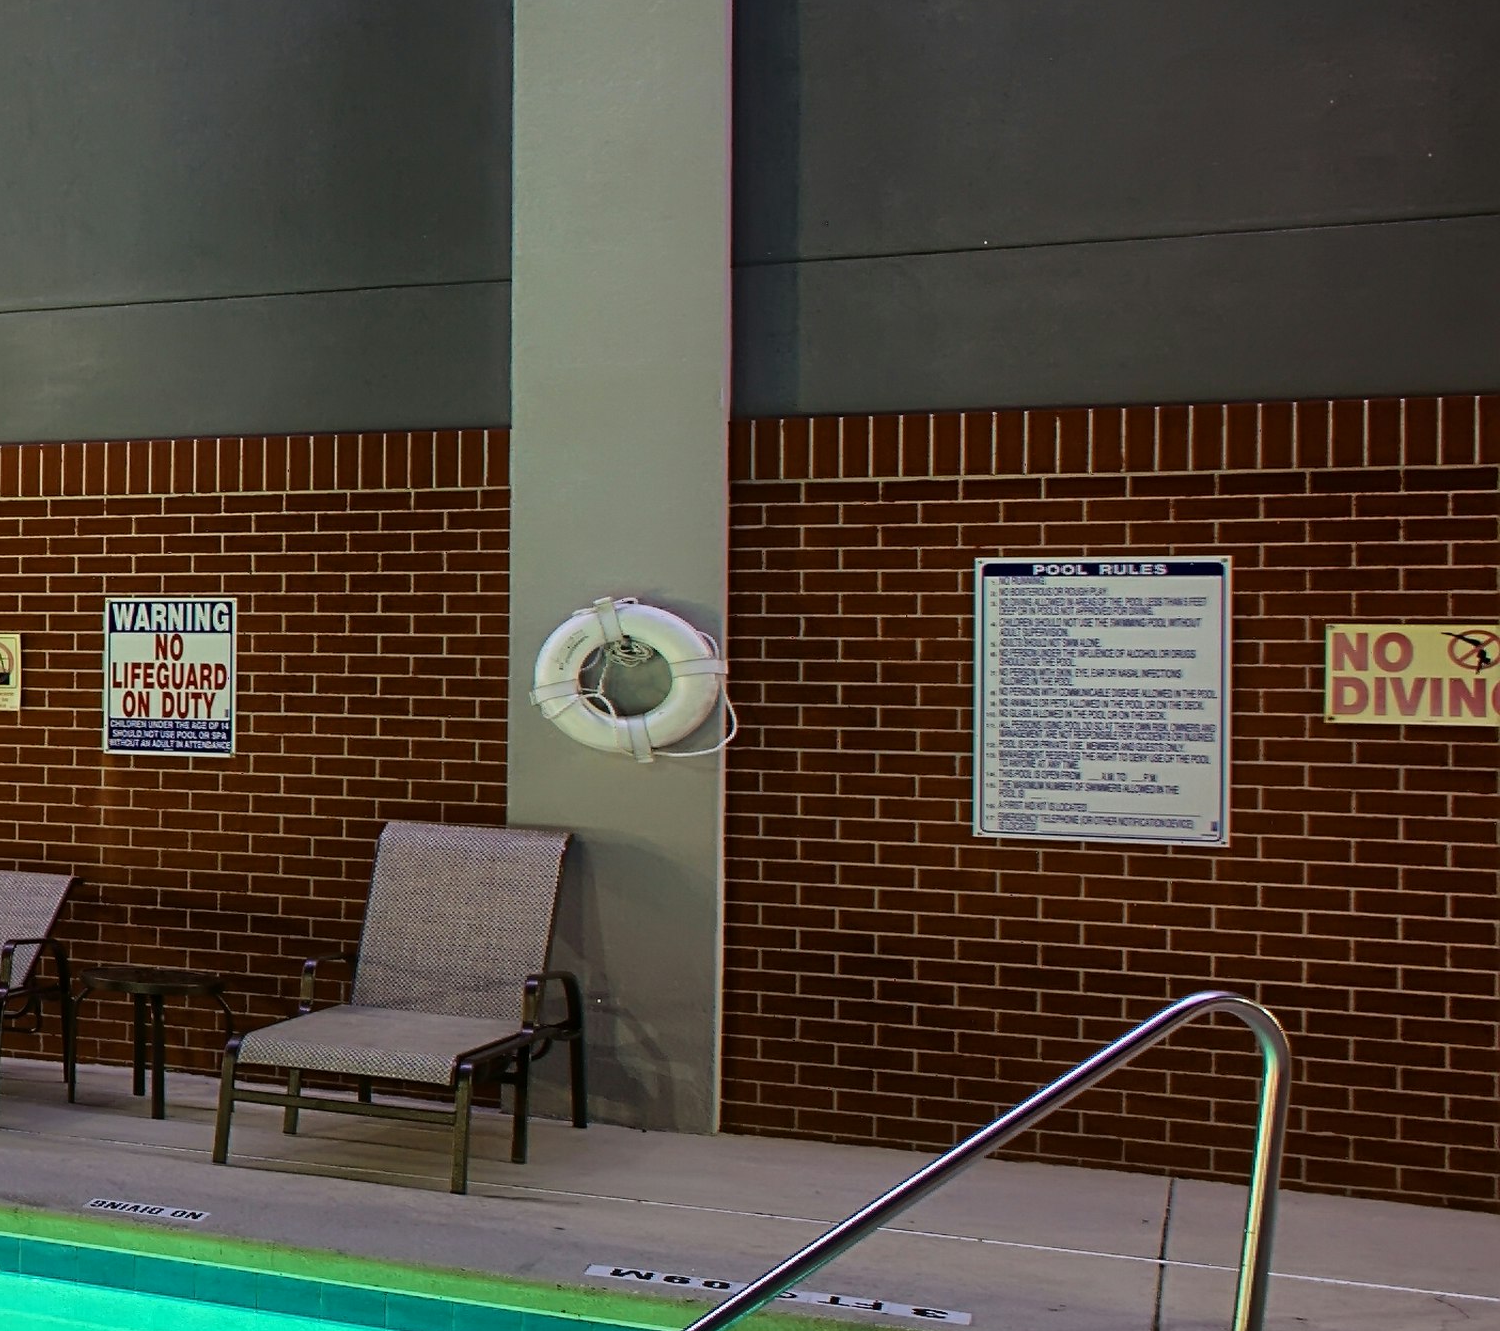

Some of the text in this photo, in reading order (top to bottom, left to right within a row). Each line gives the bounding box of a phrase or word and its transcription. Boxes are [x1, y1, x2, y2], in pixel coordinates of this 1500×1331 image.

[1032, 563, 1168, 575] POOL RULES
[112, 603, 230, 632] WARNING
[155, 634, 184, 661] NO
[1332, 632, 1414, 673] NO
[112, 662, 227, 690] LIFEGUARD
[122, 691, 216, 719] ON DUTY
[1332, 676, 1500, 717] DIVIN
[110, 720, 146, 728] CHILDREN
[175, 721, 189, 729] THE
[113, 730, 141, 738] SHOULD
[144, 730, 158, 738] NOT
[161, 731, 175, 739] USE
[177, 731, 197, 739] POOL
[185, 741, 230, 749] ATTENDANCE
[90, 1200, 204, 1220] NO DIVING
[911, 1308, 949, 1319] 3
